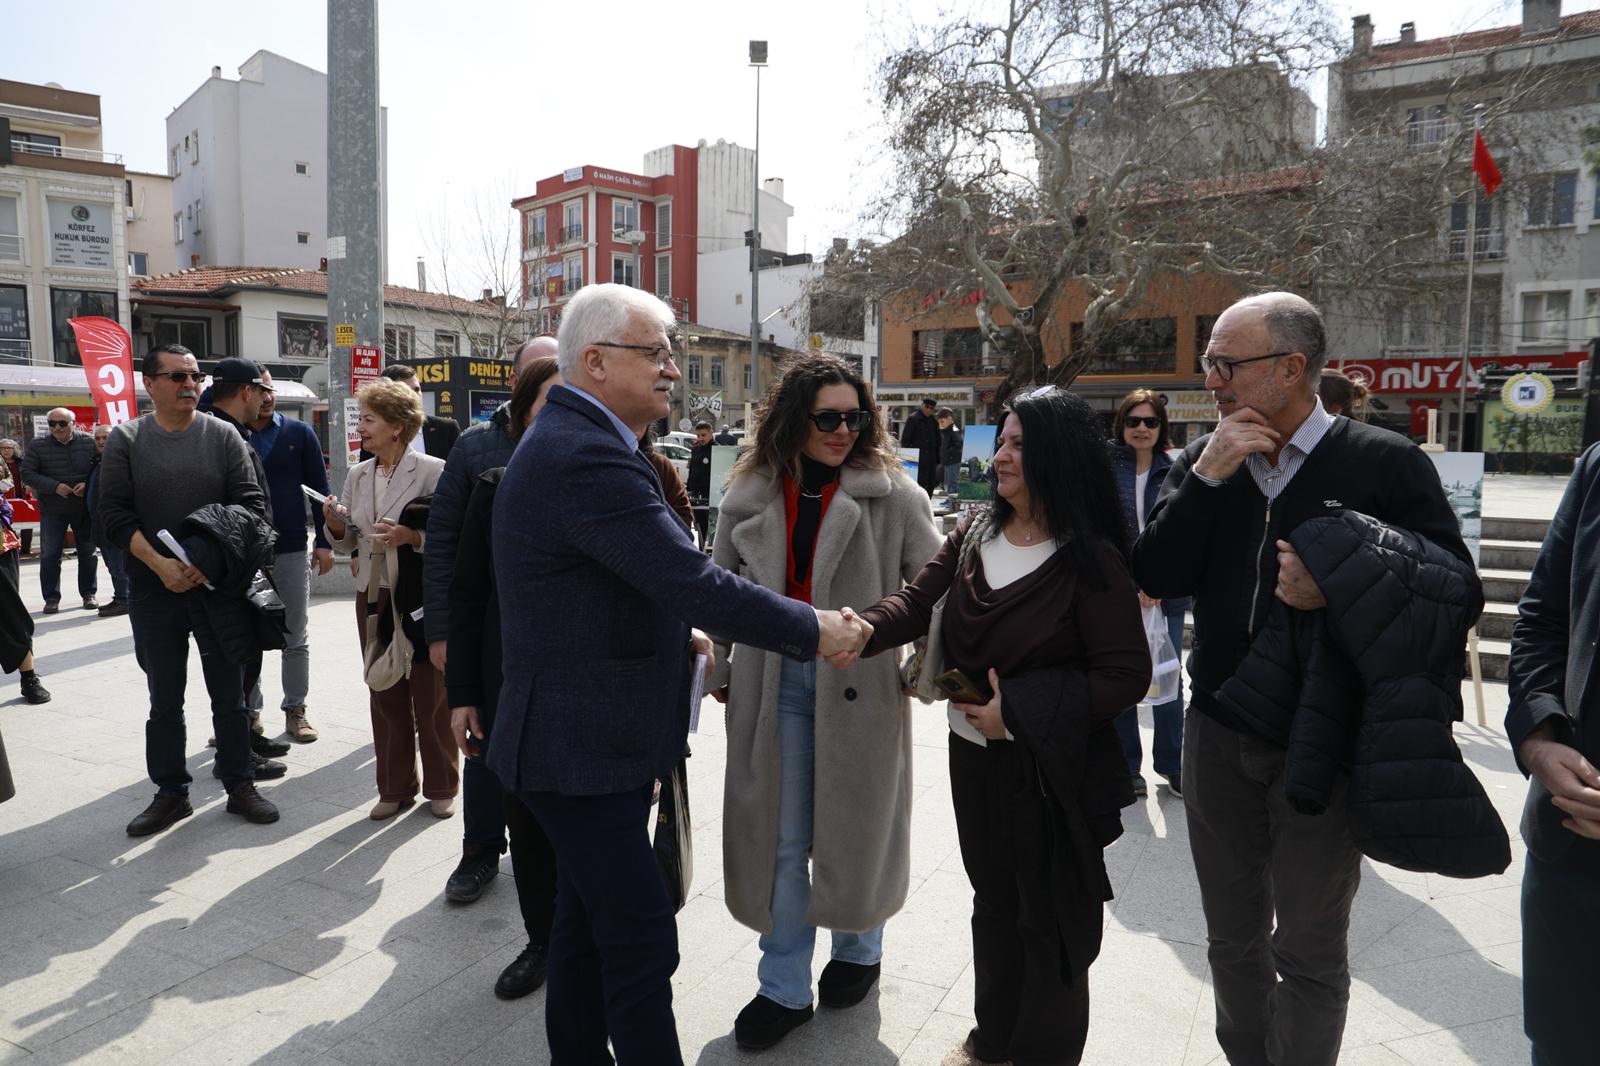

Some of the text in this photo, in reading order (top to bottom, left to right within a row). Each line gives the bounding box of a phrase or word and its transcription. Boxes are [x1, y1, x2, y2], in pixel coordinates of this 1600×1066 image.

[68, 222, 96, 233] KÖRFEZ
[54, 232, 80, 241] HUKUK
[469, 361, 502, 378] DENİZ
